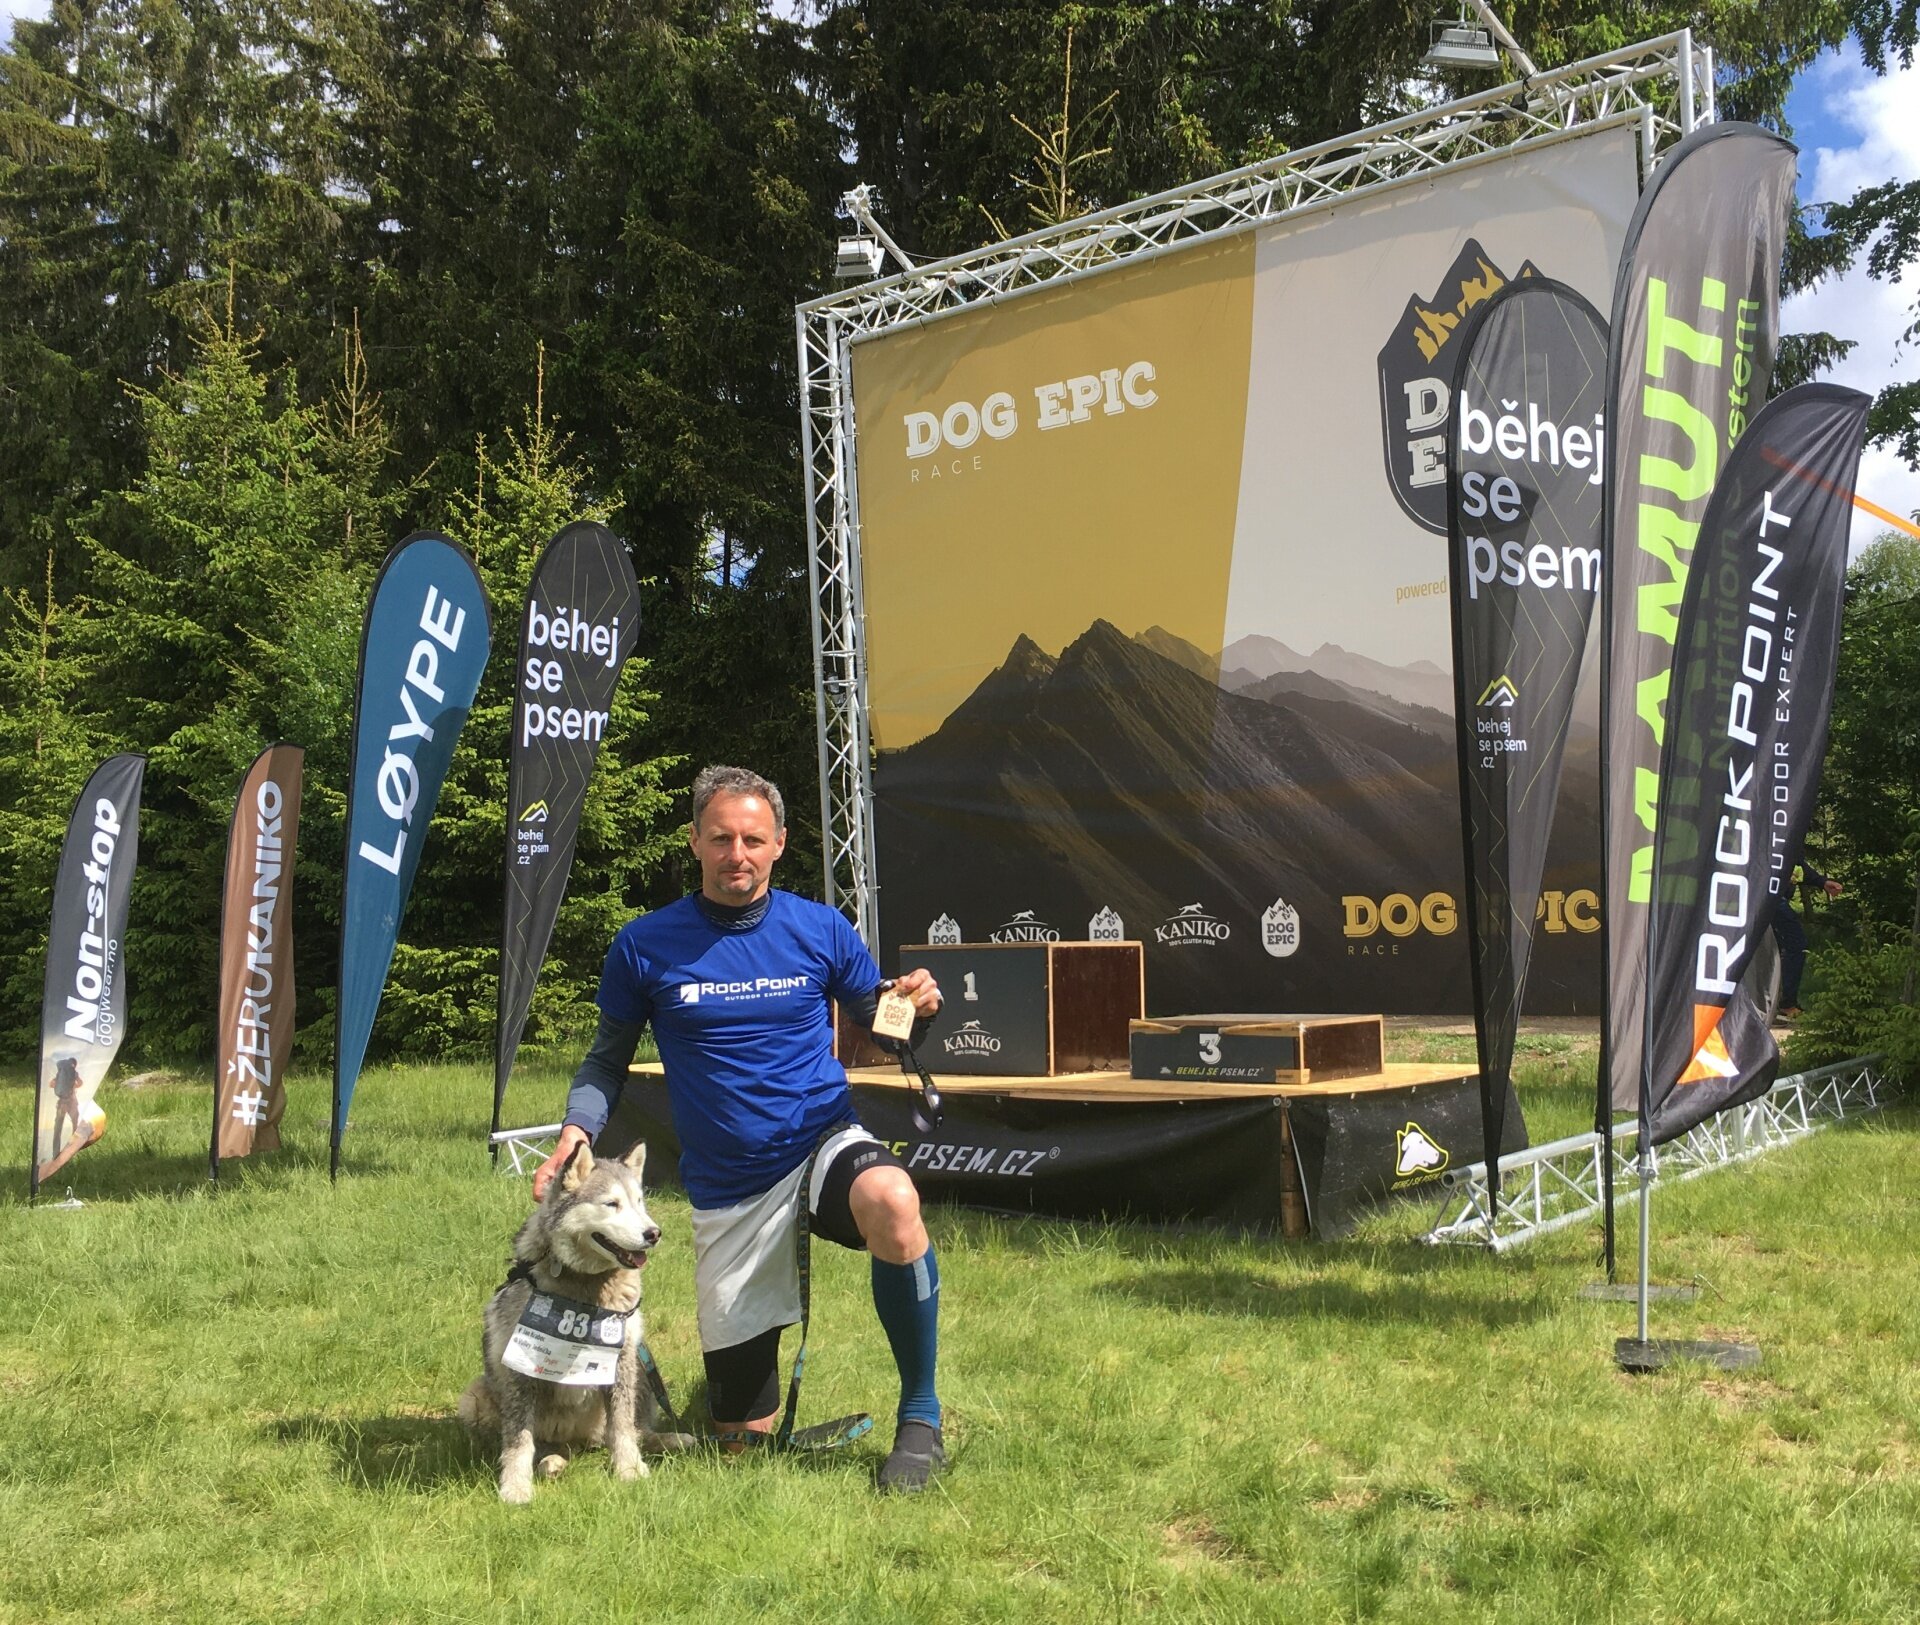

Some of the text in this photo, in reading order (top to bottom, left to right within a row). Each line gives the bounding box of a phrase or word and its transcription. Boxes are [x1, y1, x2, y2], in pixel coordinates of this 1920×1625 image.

[904, 361, 1159, 459] DOG EPIC
[1460, 391, 1604, 485] běhej
[911, 455, 982, 483] RACE
[1462, 471, 1521, 522] se
[1466, 535, 1602, 600] psem
[1396, 576, 1447, 603] powered
[528, 600, 619, 669] běhej
[525, 656, 563, 693] se
[359, 584, 466, 875] LØYPE
[523, 702, 608, 747] psem
[1477, 717, 1511, 737] behej
[1479, 739, 1527, 756] se psem
[1696, 490, 1791, 995] ROCK POINT
[1768, 606, 1797, 894] OUTDOOR EXPERT
[1480, 756, 1495, 768] .cz
[517, 844, 528, 853] se
[518, 829, 544, 843] behej
[517, 856, 530, 865] .cz
[64, 797, 122, 1045] Non-stop
[1267, 922, 1294, 934] DOG
[1342, 892, 1458, 938] DOG
[932, 934, 957, 944] DOG
[989, 926, 1060, 944] KANIKO
[1094, 929, 1119, 939] DOG
[1154, 920, 1230, 943] KANIKO
[1267, 934, 1294, 944] EPIC
[227, 780, 283, 1126] #ŽERUKANIKO
[1347, 945, 1399, 955] RACE
[97, 939, 118, 1046] dogwear.no
[701, 976, 809, 995] ROCK POINT
[725, 990, 791, 1001] OUTDOOR EXPERT
[963, 971, 979, 1001] 1
[886, 1004, 907, 1016] DOG
[943, 1034, 1001, 1053] KANIKO
[1199, 1033, 1222, 1065] 3
[1176, 1066, 1205, 1076] BEHEJ
[1206, 1066, 1218, 1076] SE
[558, 1309, 590, 1338] 83
